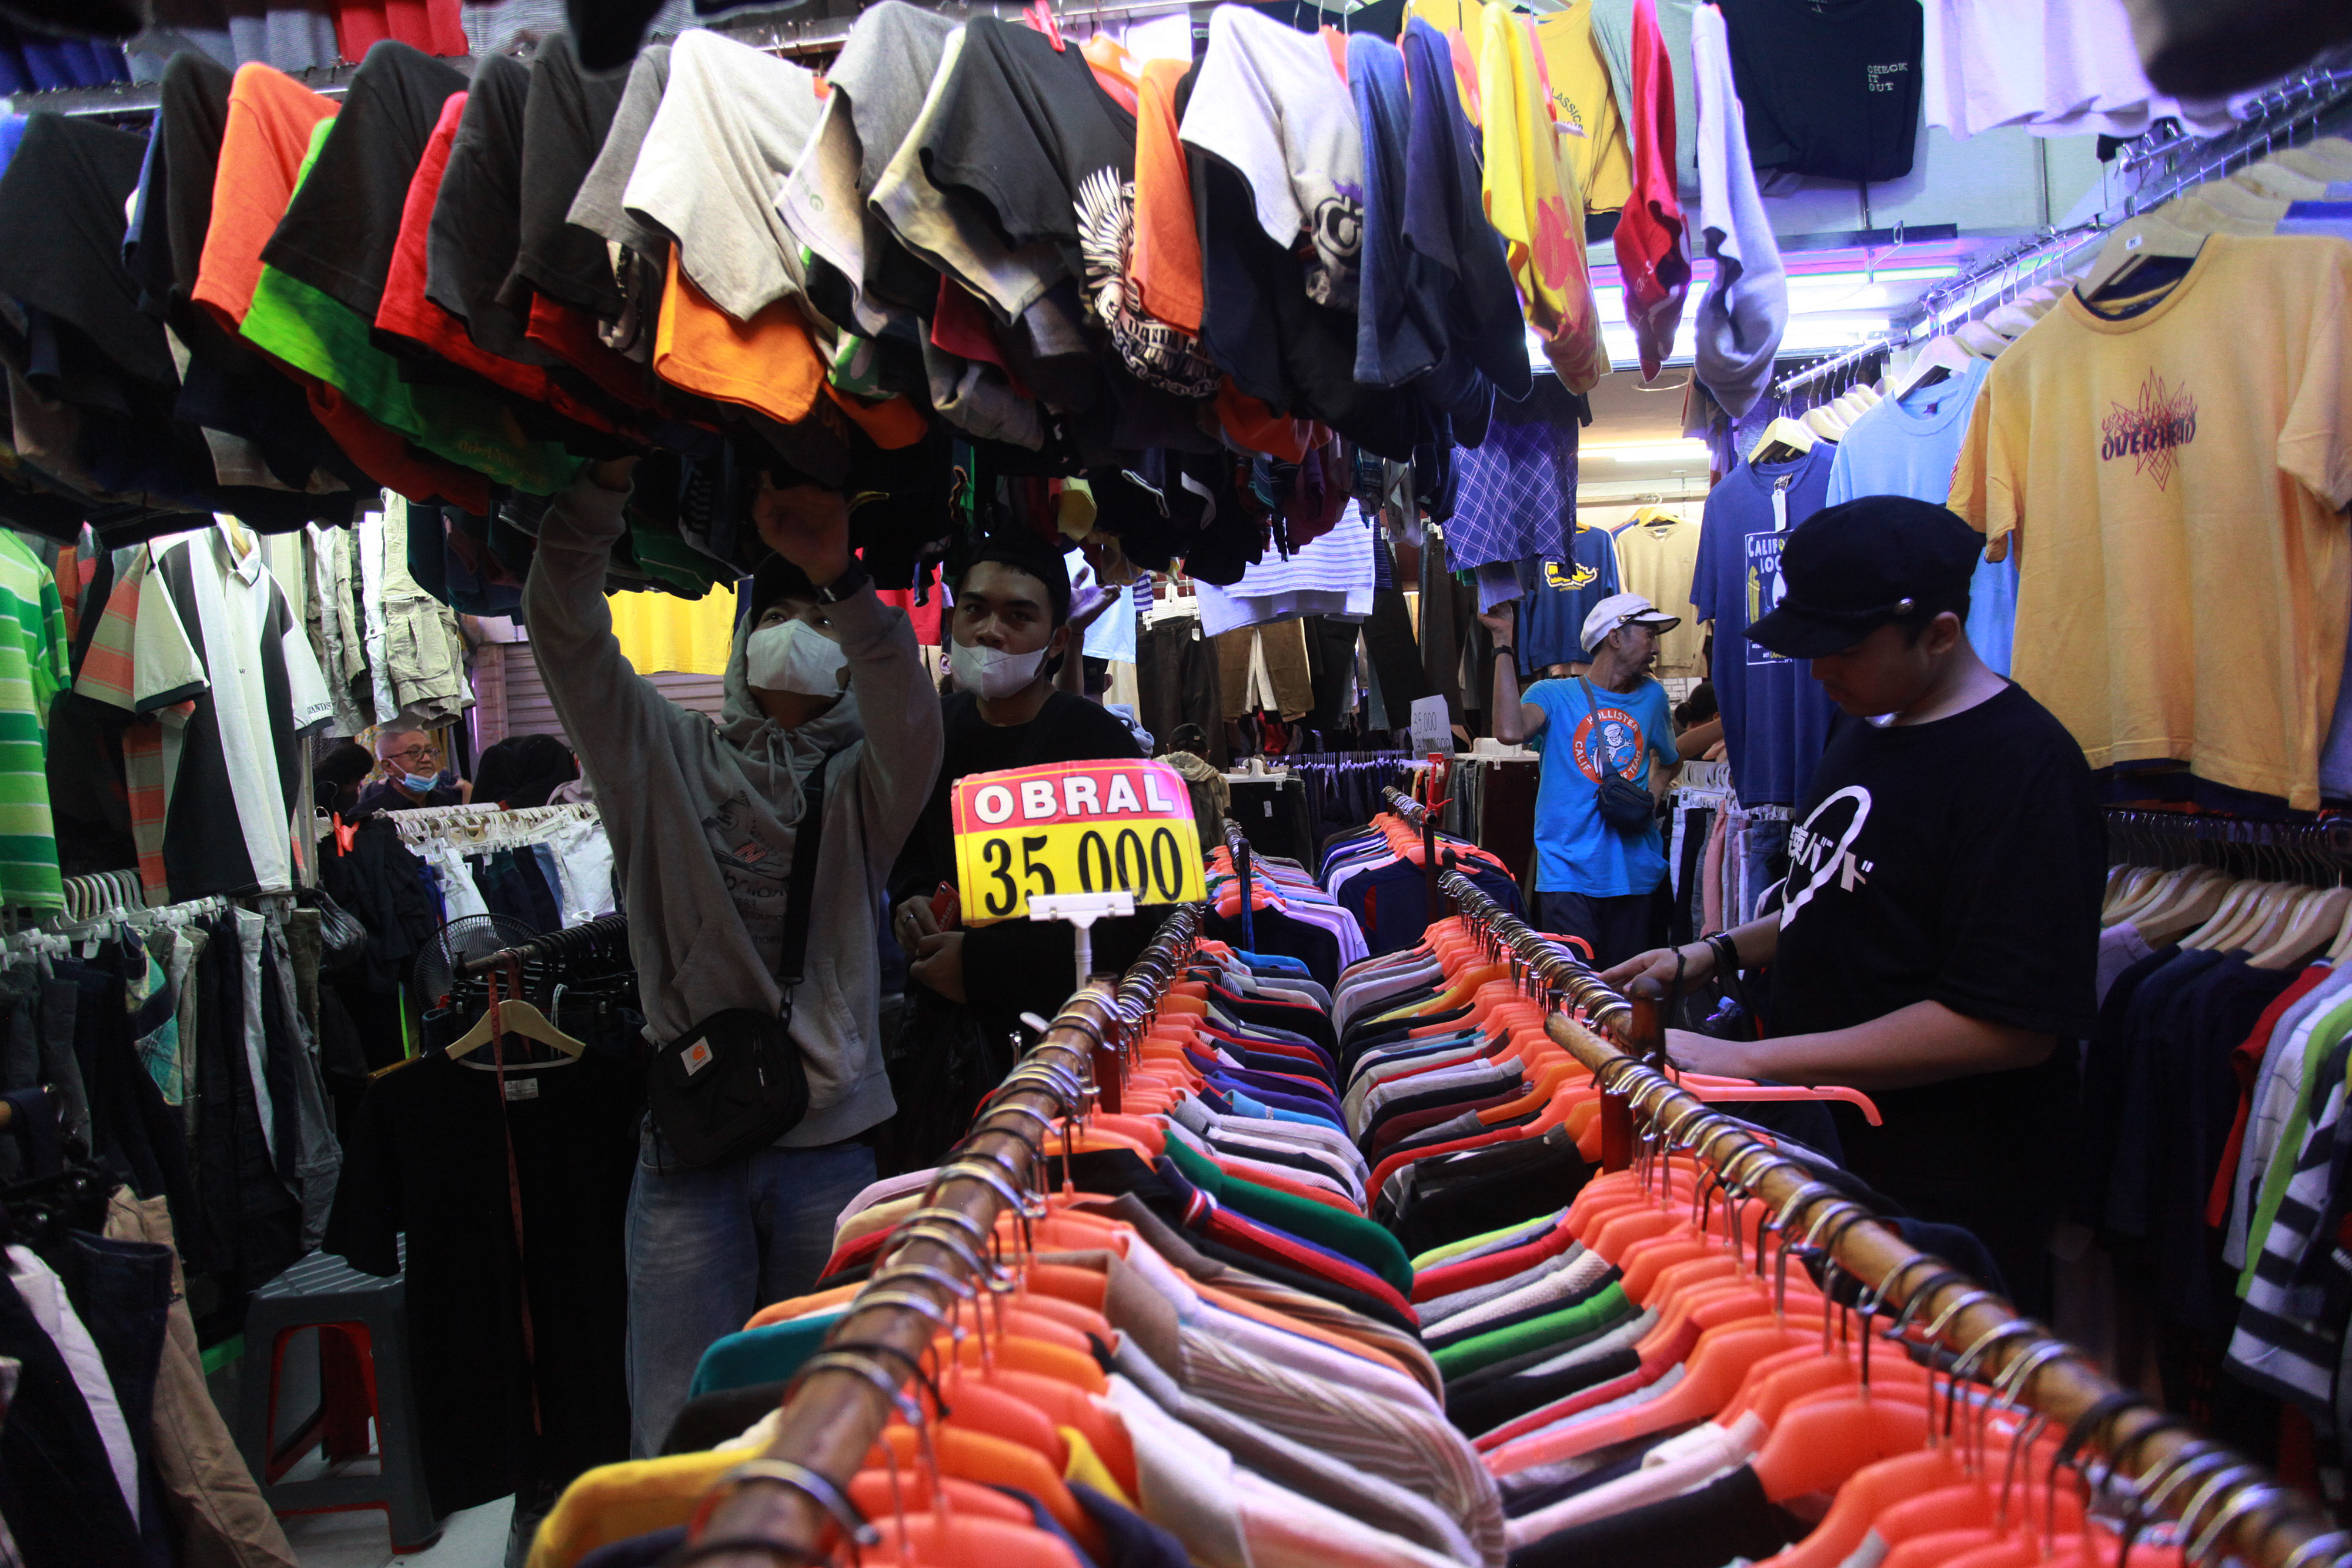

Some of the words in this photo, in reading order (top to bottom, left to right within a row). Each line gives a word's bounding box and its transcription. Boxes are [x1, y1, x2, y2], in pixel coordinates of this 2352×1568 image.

[1867, 62, 1908, 74] CHECK
[1867, 74, 1879, 83] IT
[1868, 82, 1894, 92] OUT
[1747, 536, 1788, 558] CALIFO
[1575, 741, 1592, 771] CALIF
[974, 773, 1175, 824] OBRAL
